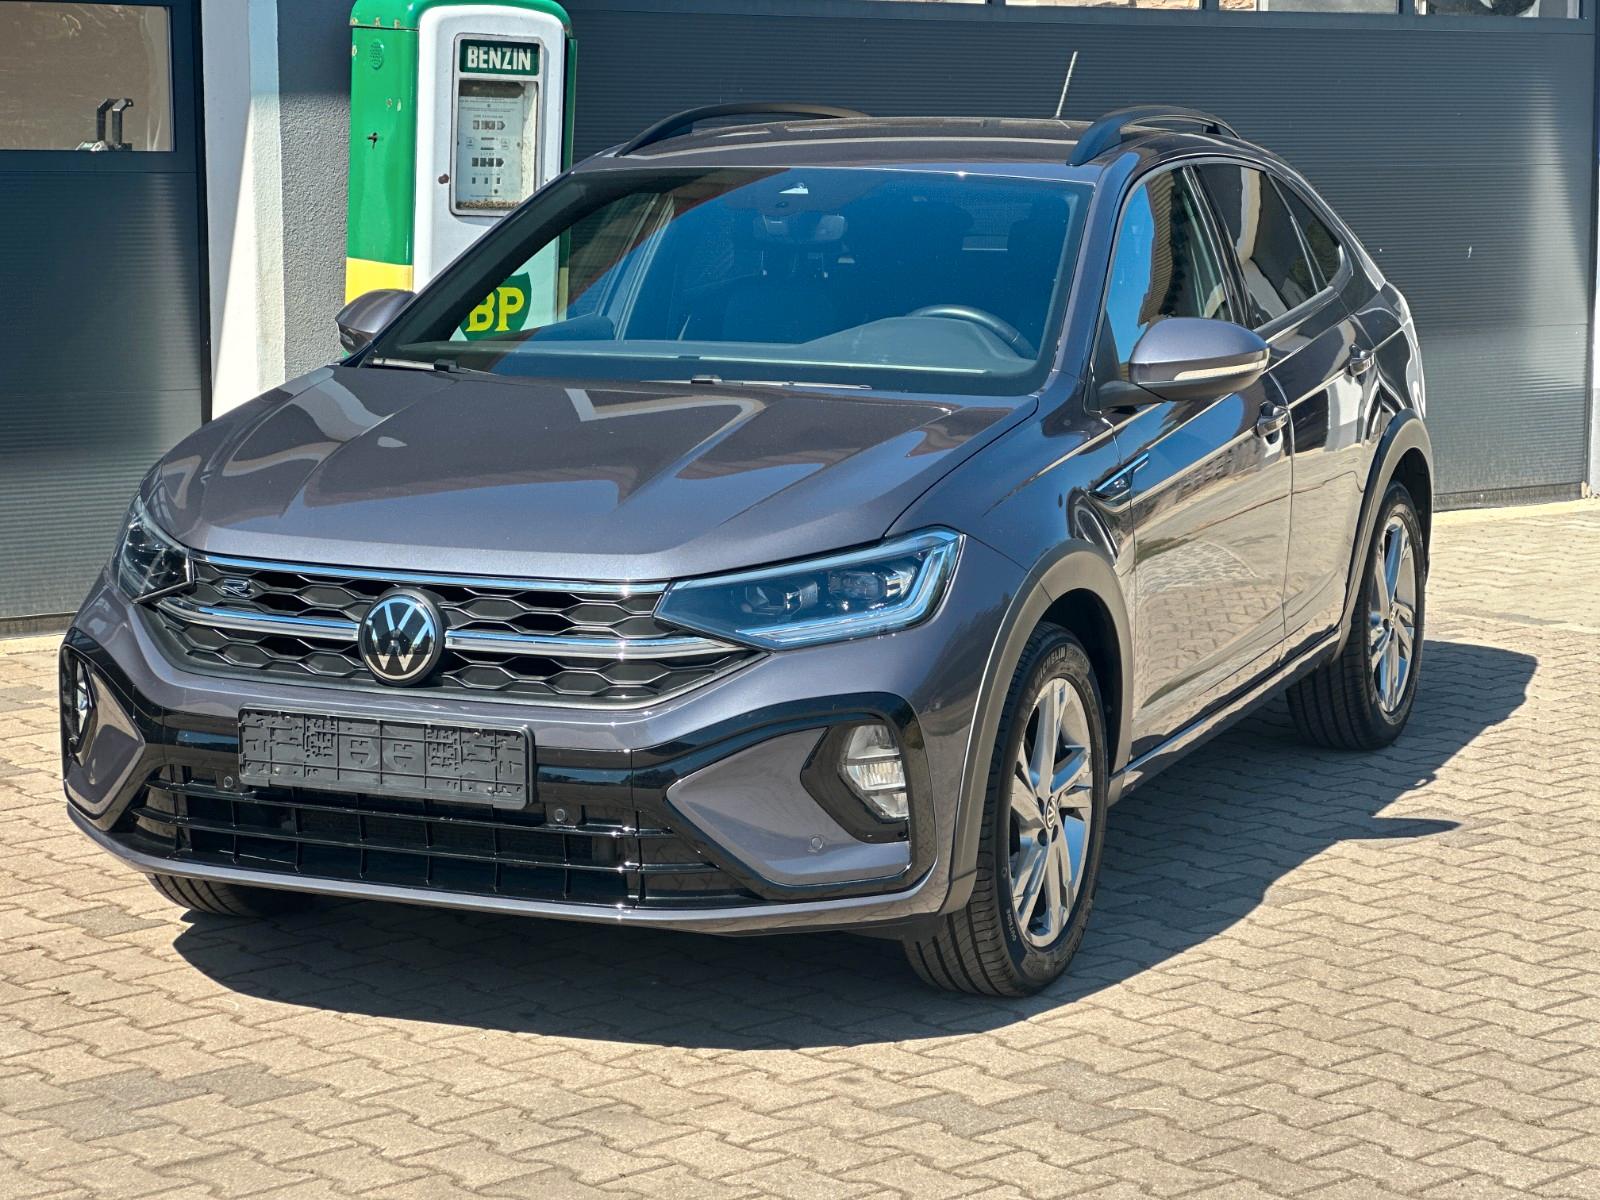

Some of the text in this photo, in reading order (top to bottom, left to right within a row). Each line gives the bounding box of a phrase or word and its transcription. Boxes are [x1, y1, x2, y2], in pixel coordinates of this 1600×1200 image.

[467, 45, 531, 71] BENZIN
[465, 286, 525, 332] BP
[365, 596, 436, 680] VW
